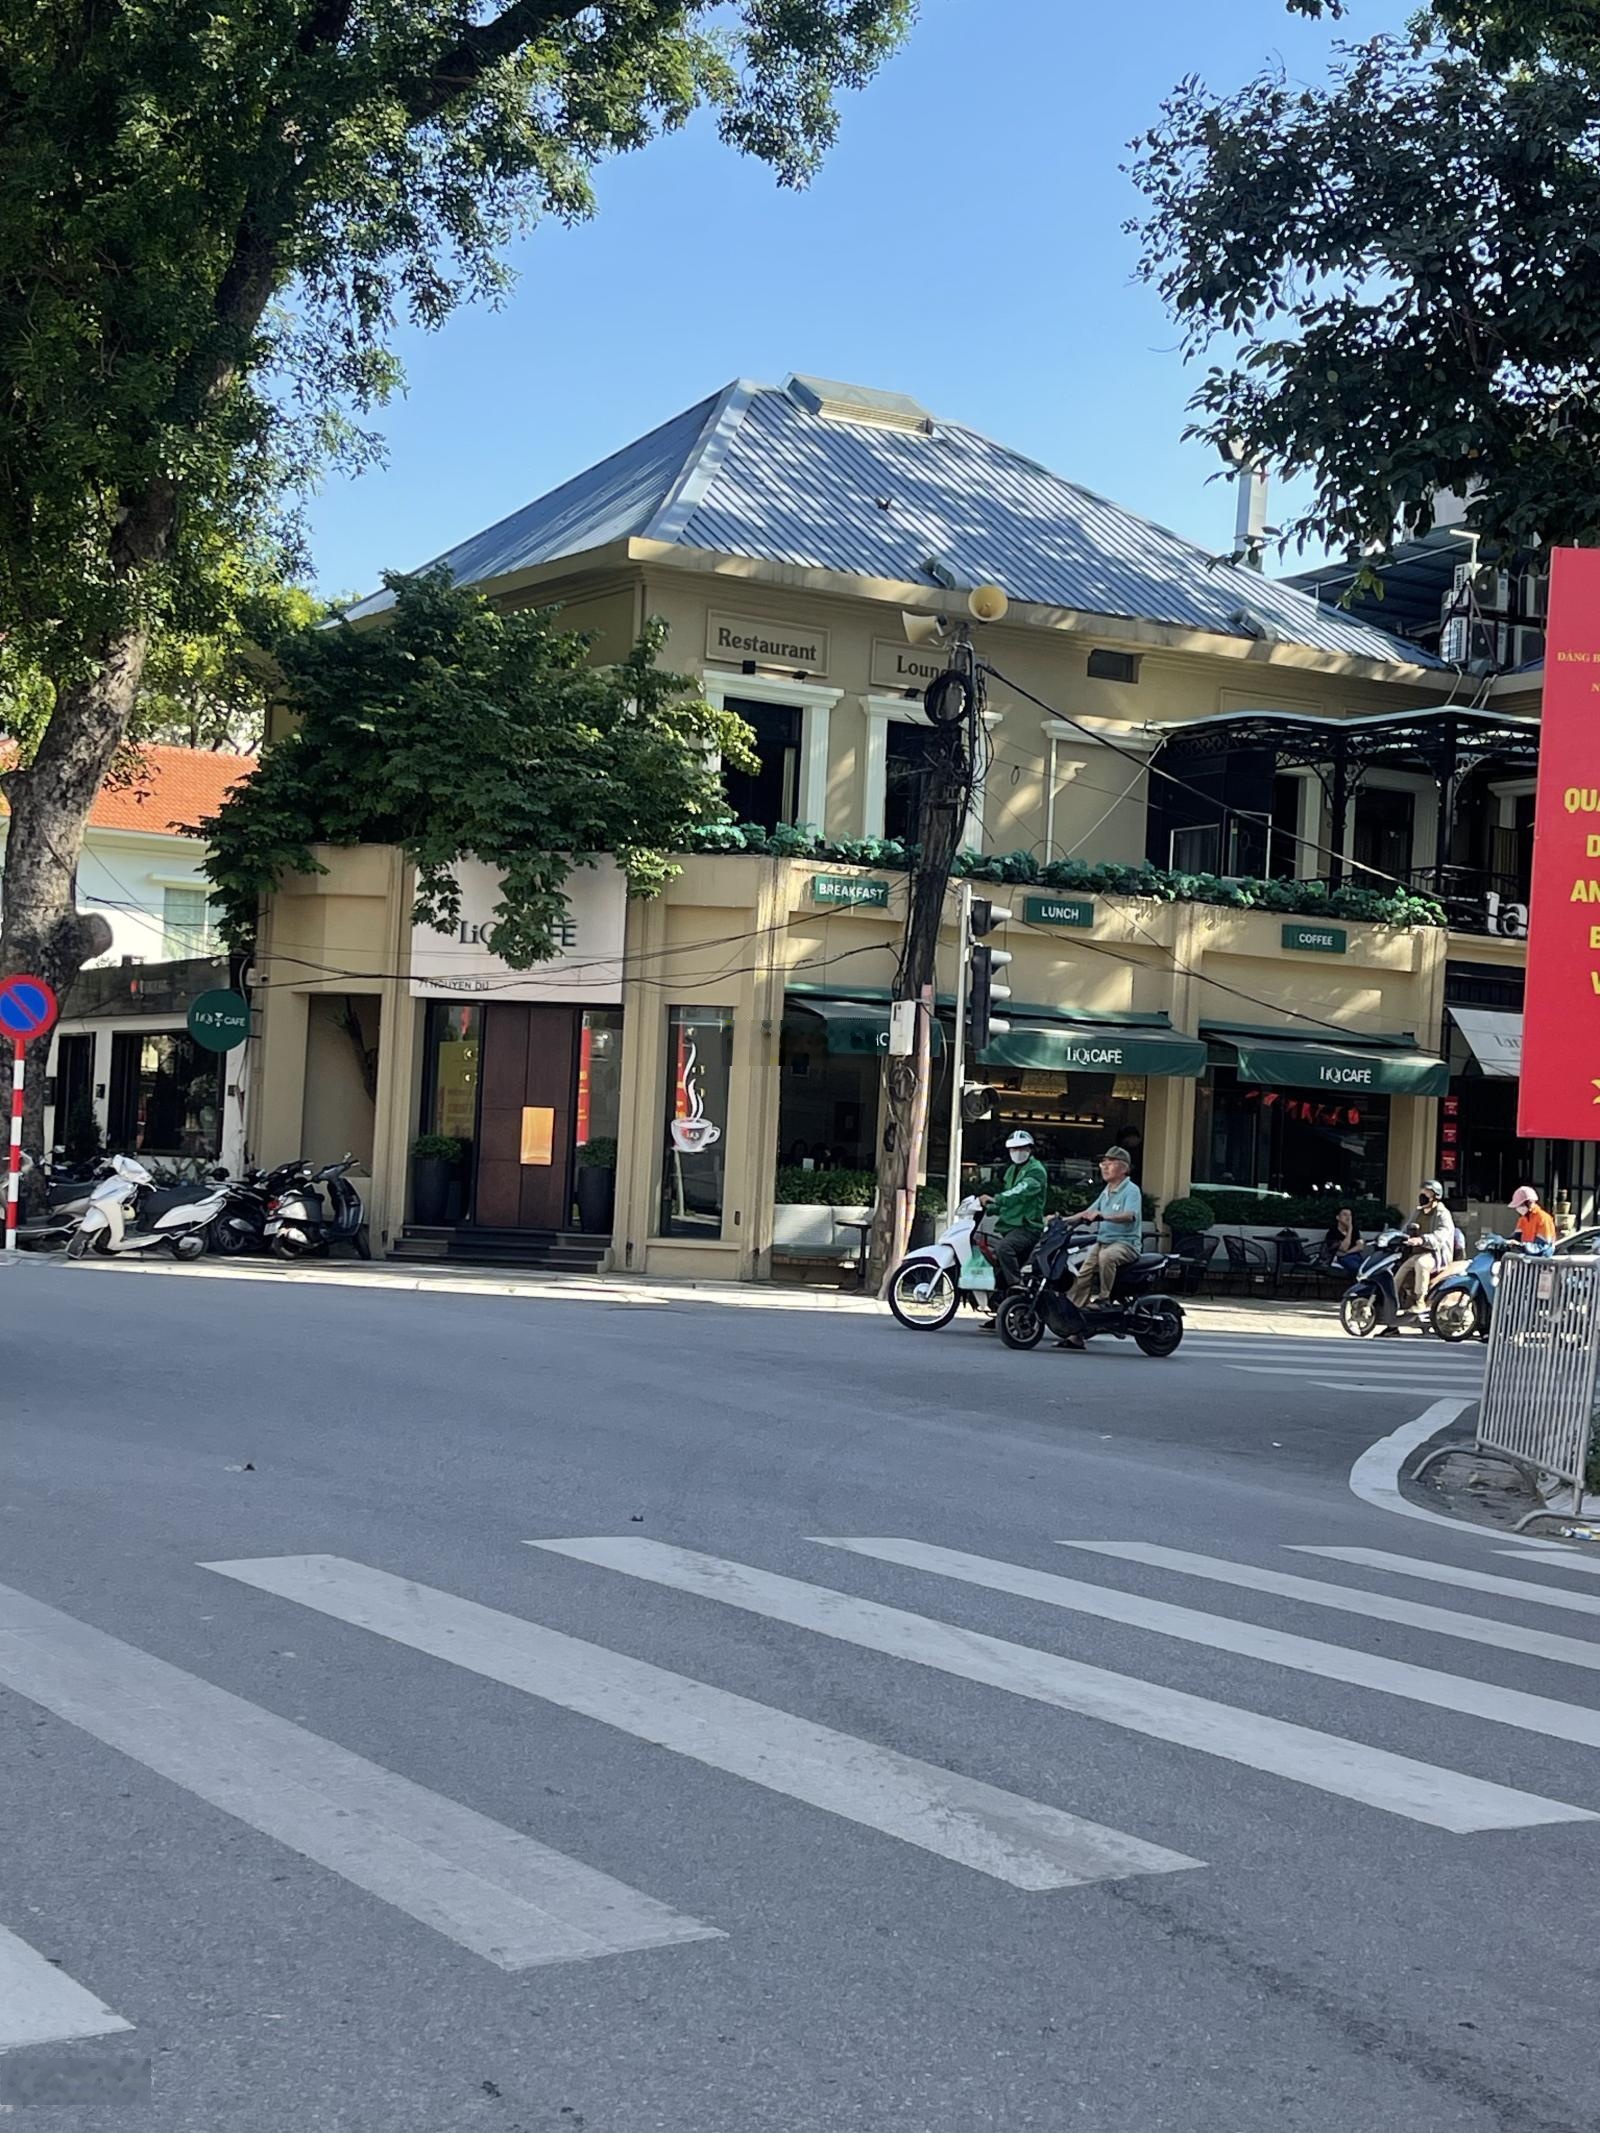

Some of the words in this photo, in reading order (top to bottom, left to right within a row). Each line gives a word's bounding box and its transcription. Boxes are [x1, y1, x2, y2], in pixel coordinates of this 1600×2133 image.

[718, 627, 817, 661] Restaurant
[896, 654, 949, 678] Loun
[818, 883, 884, 900] BREAKFAST
[1041, 905, 1079, 920] LUNCH
[1299, 933, 1334, 946] COFFEE
